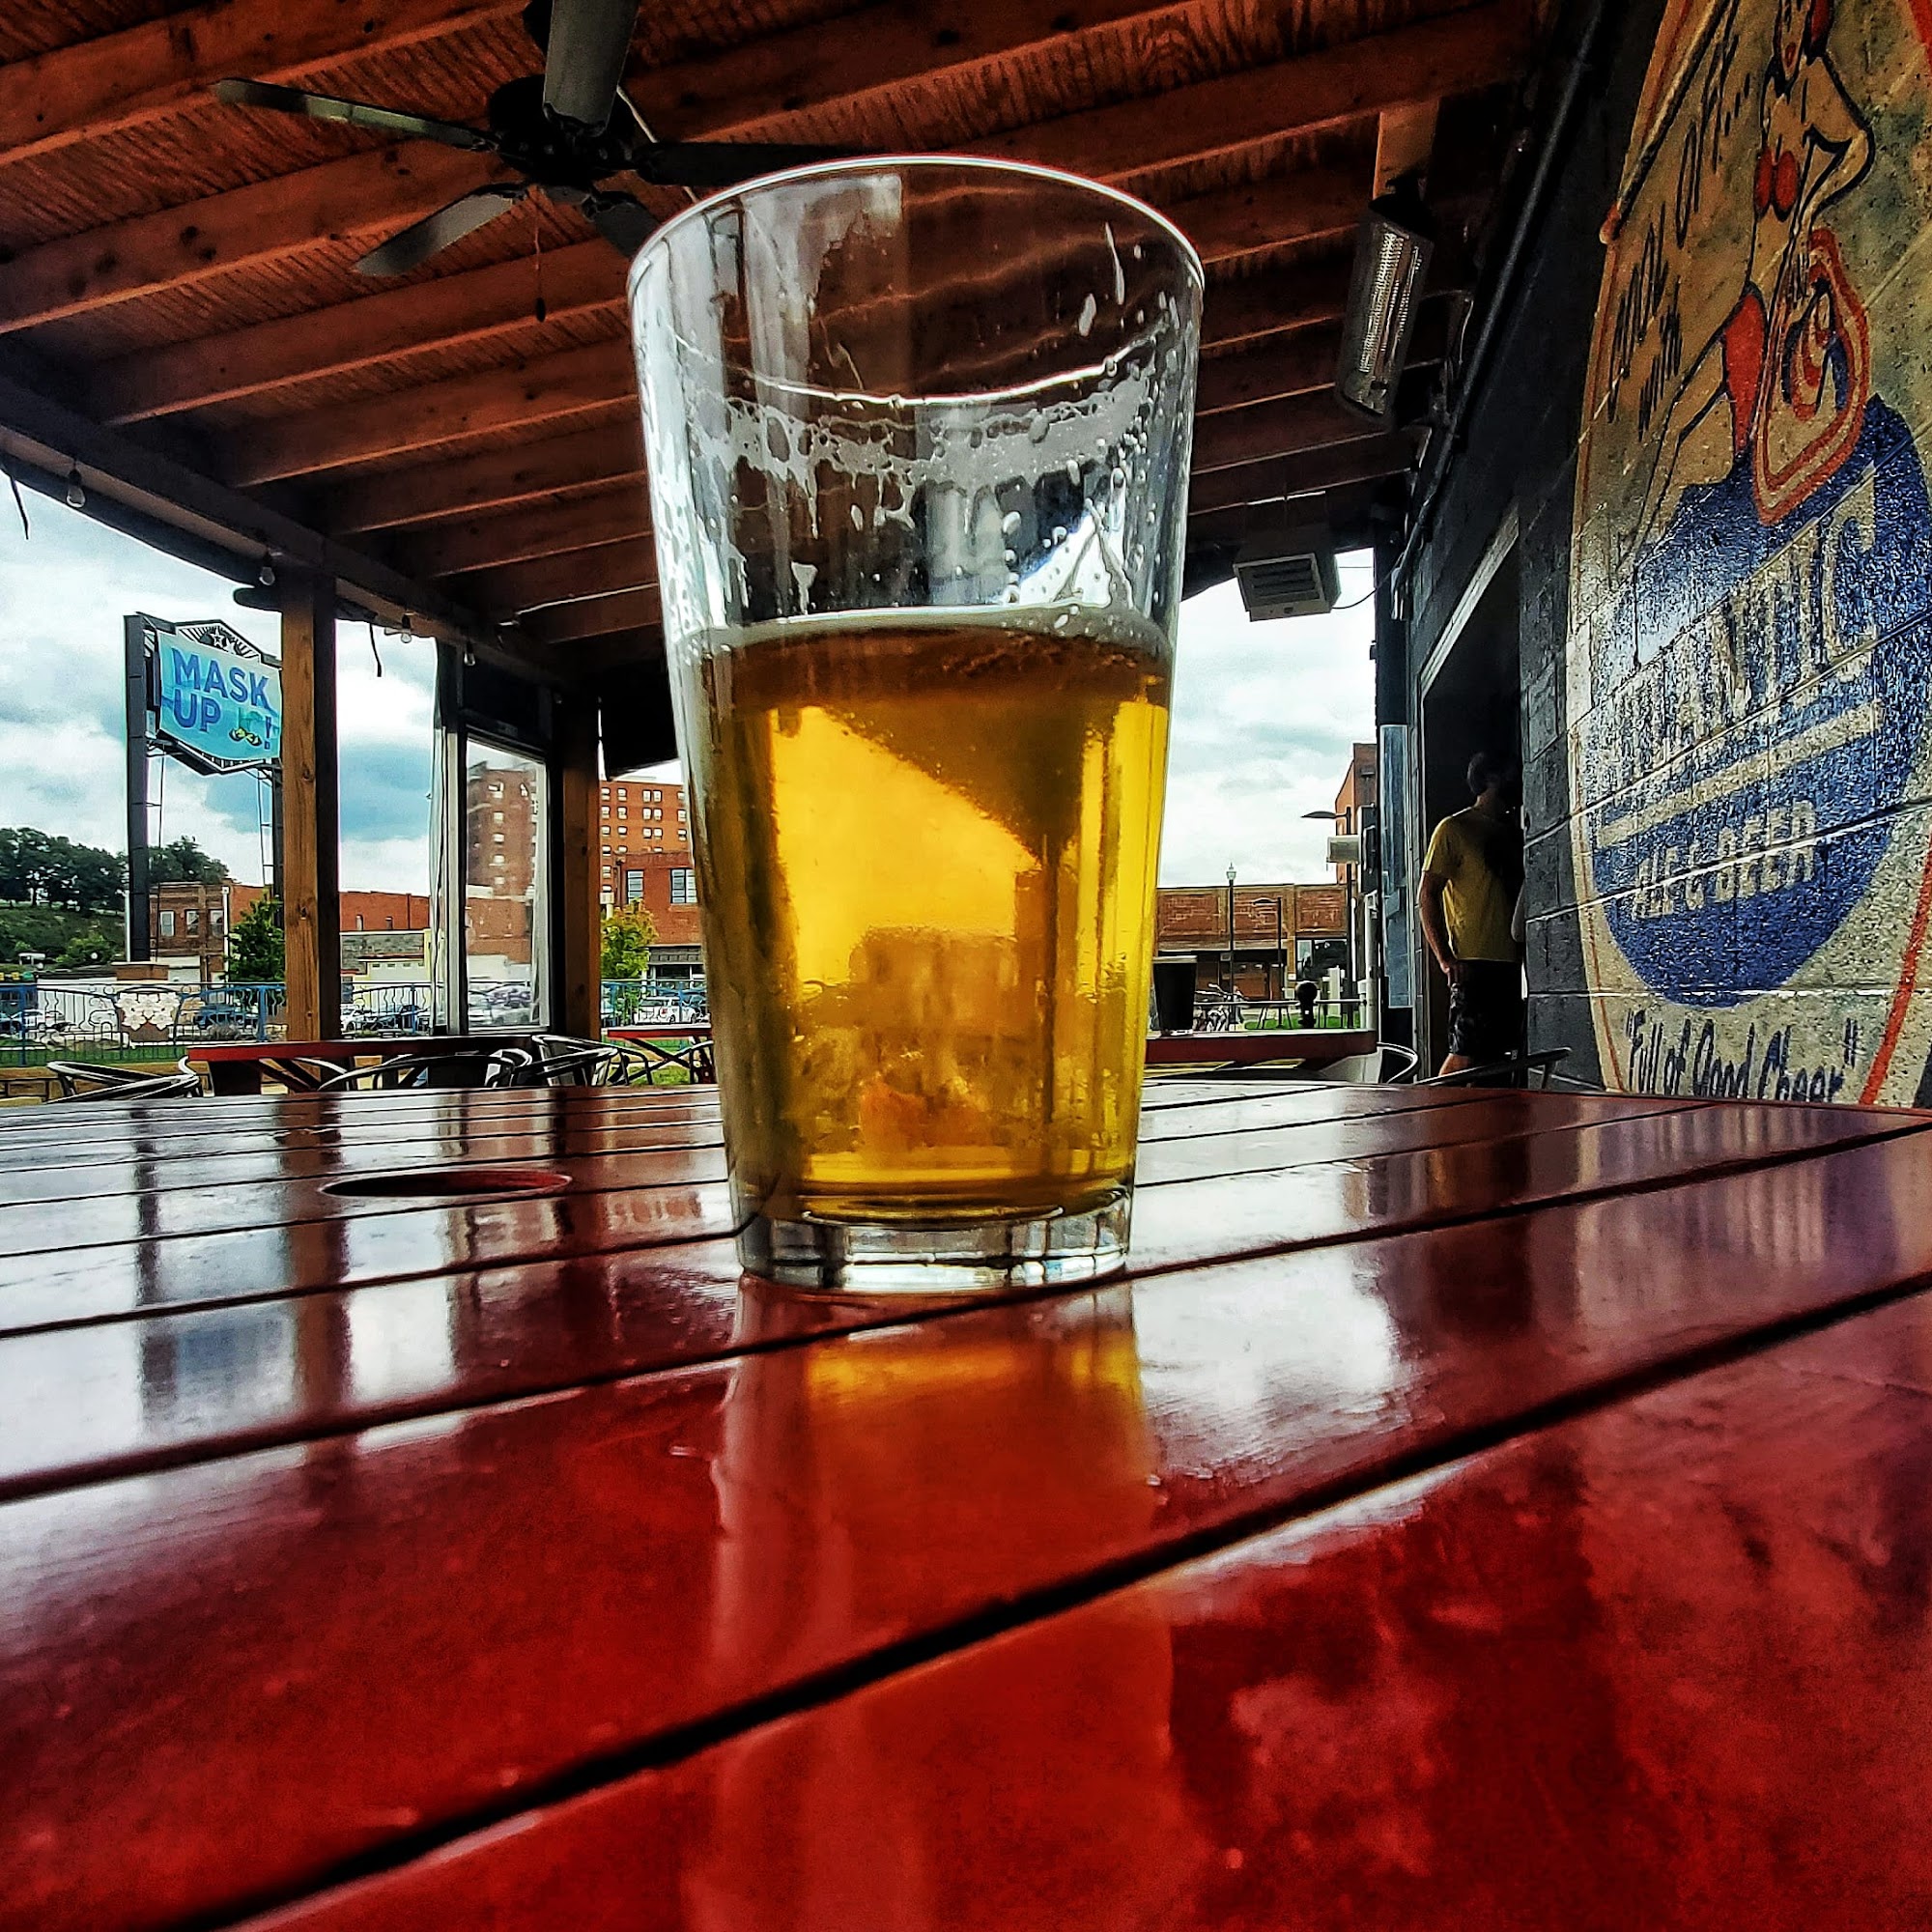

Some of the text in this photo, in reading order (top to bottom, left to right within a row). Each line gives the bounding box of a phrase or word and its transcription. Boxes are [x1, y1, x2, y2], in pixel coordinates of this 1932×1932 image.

[171, 646, 270, 710] MASK
[172, 688, 222, 732] UP
[1632, 846, 1679, 921] ALE
[1716, 800, 1816, 902] BEER
[1664, 1018, 1690, 1095] of
[1693, 1018, 1754, 1099] Good
